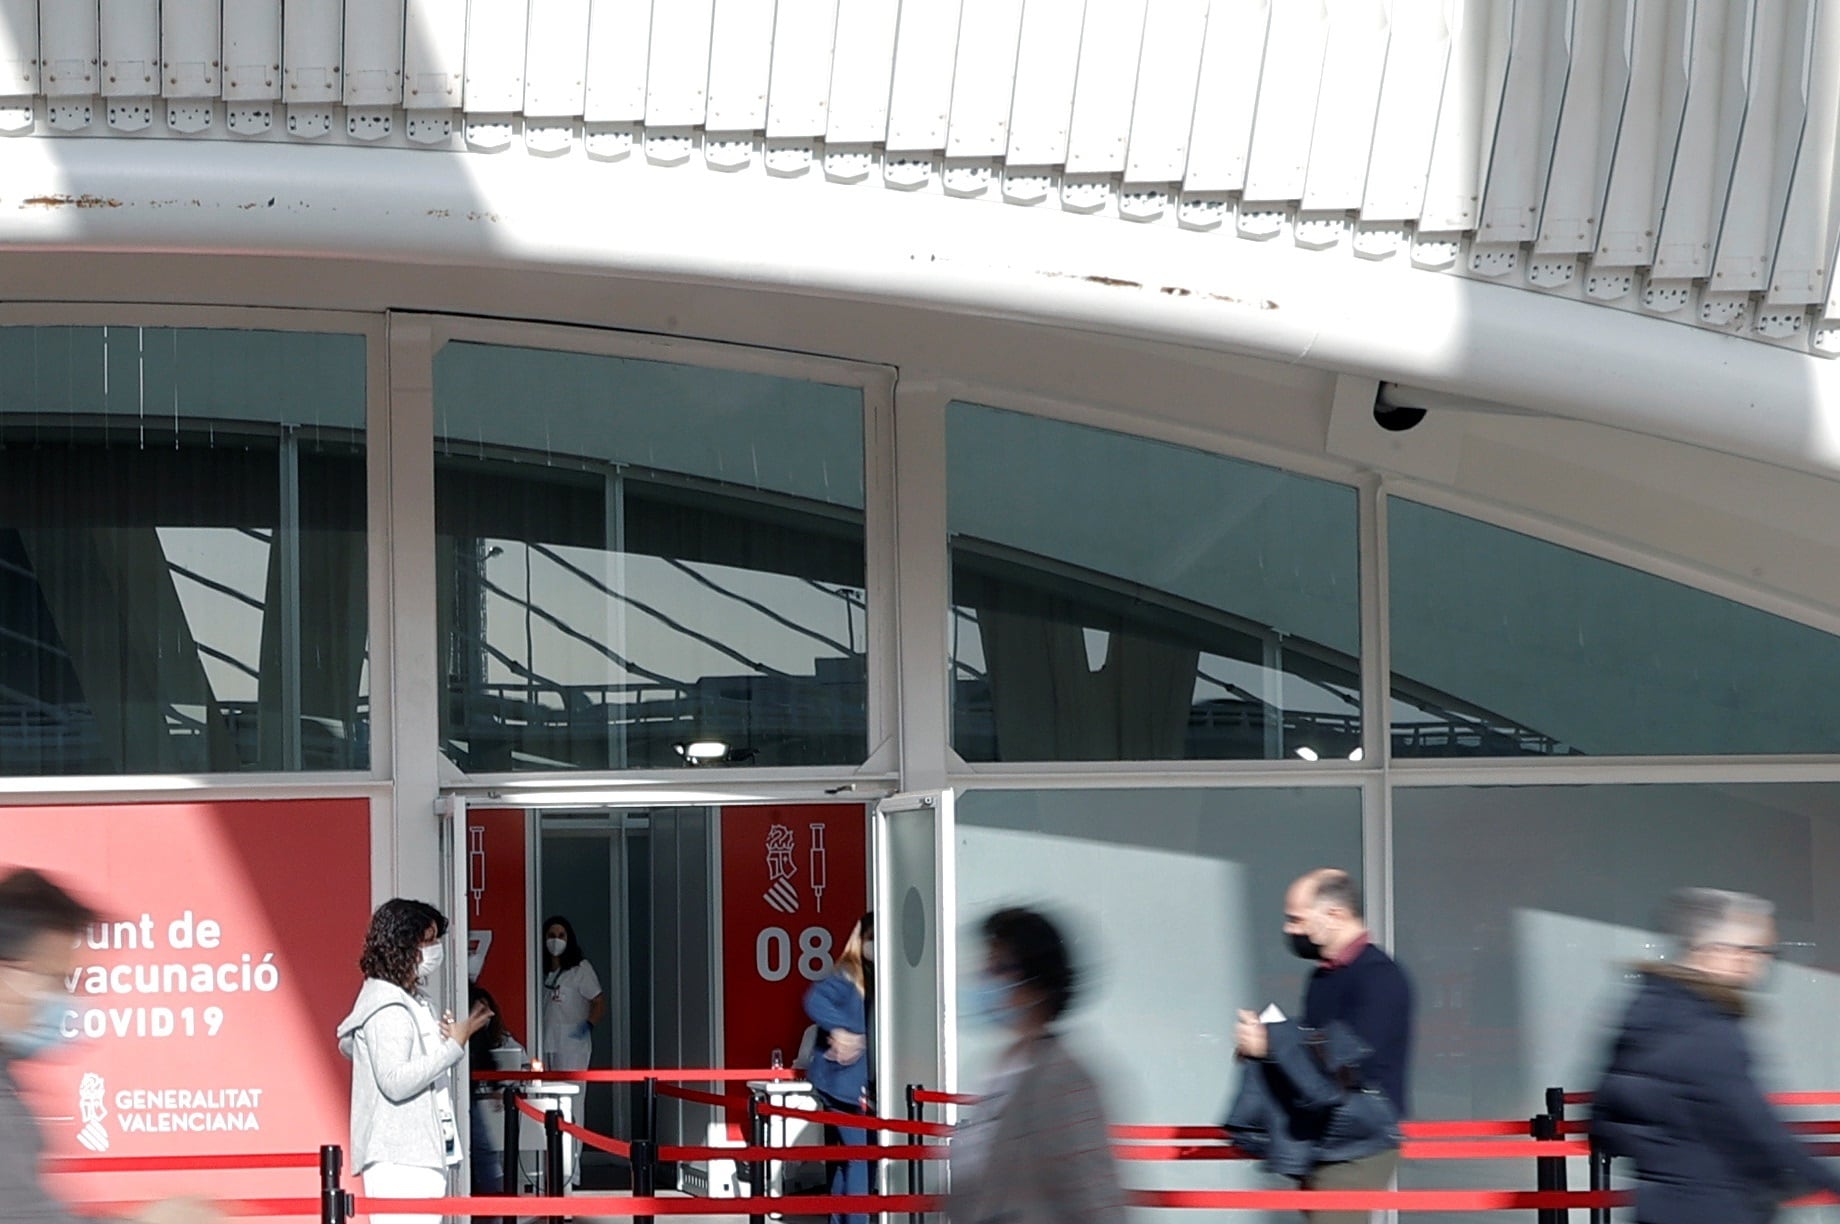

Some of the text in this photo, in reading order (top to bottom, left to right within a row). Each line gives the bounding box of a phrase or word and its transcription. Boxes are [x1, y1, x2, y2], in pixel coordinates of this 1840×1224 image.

[168, 910, 221, 949] de
[63, 952, 280, 994] vacunació
[468, 929, 493, 984] 7
[756, 926, 834, 982] 08
[60, 1006, 225, 1038] COVID19
[115, 1088, 263, 1110] GENERALITAT
[117, 1112, 260, 1133] VALENCIANA
